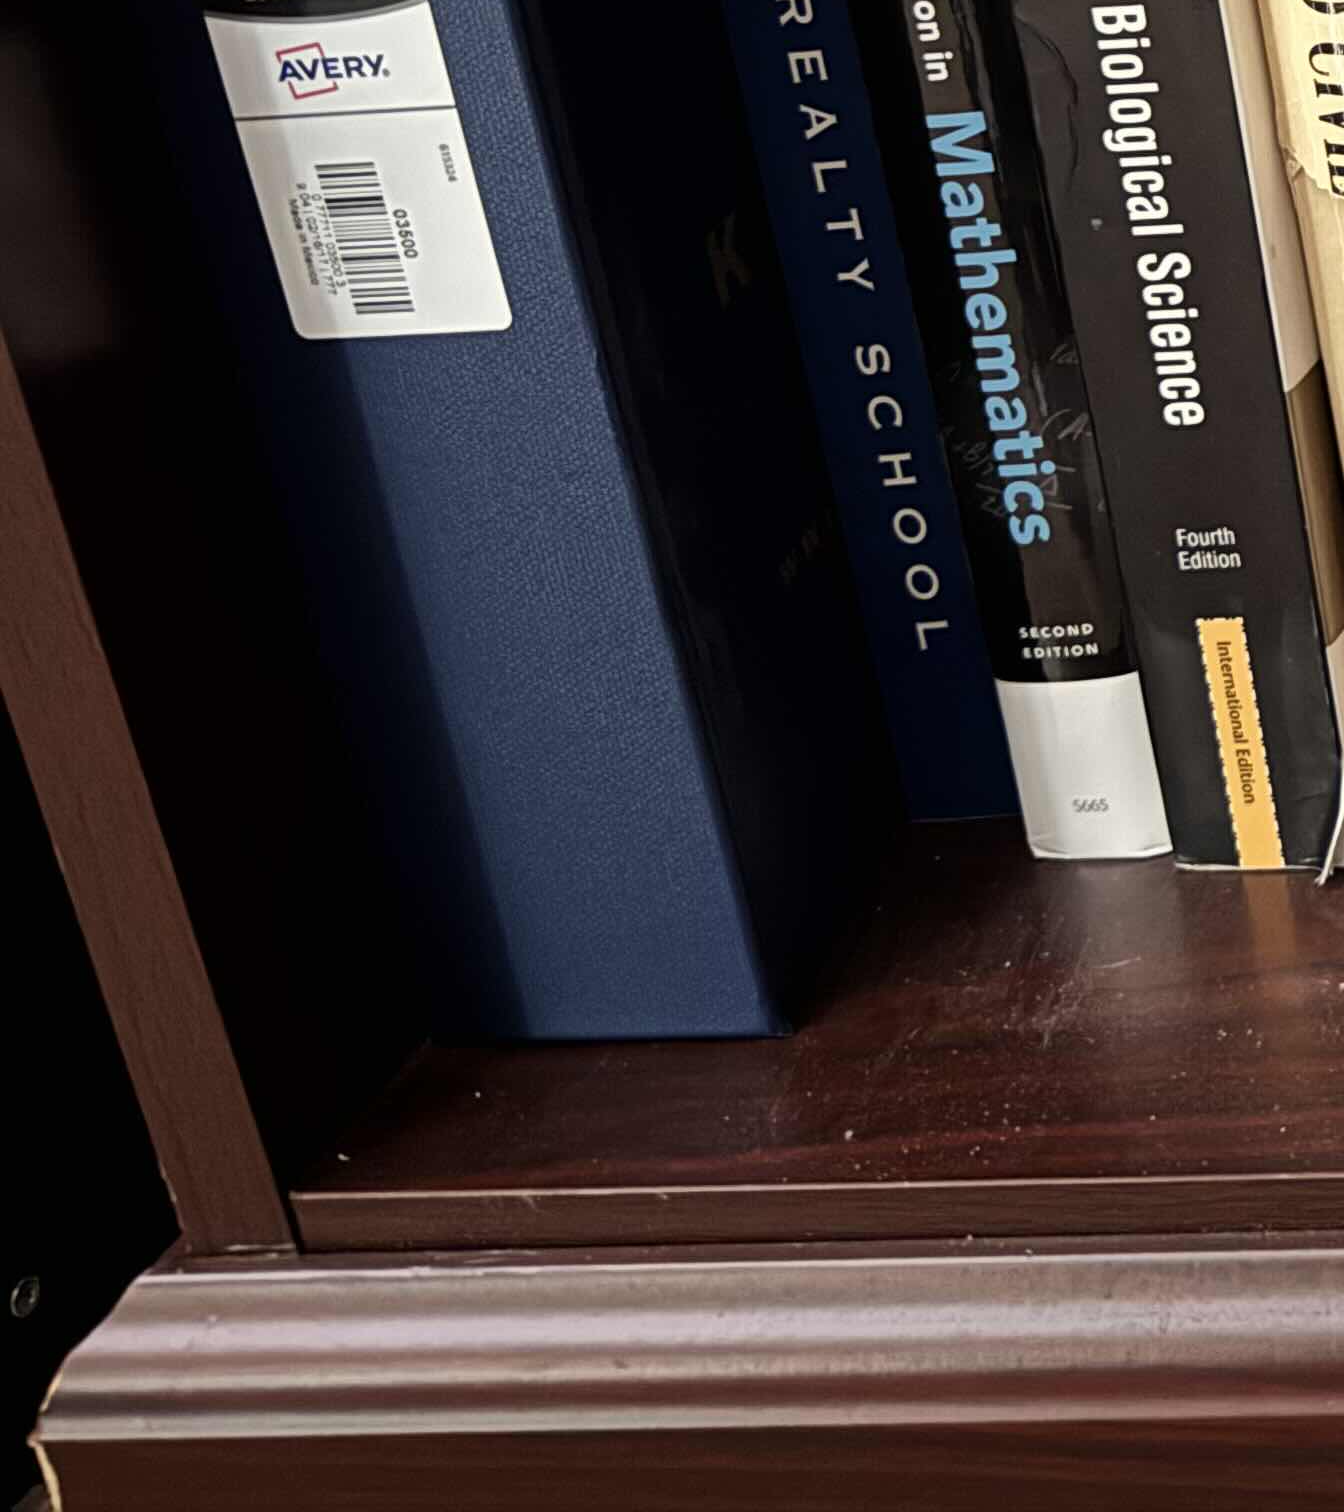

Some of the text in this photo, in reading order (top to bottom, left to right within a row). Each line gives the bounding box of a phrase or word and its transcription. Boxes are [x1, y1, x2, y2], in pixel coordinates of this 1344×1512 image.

[277, 54, 385, 84] AVERY
[922, 46, 950, 83] in
[392, 208, 417, 259] 03500
[1091, 3, 1206, 428] Biological Science
[926, 111, 1058, 546] Mathematics
[855, 342, 950, 652] SCHOOL
[1176, 527, 1237, 549] Fourth
[1177, 548, 1242, 571] Edition
[1018, 621, 1095, 639] SECOND
[1021, 642, 1099, 660] EDITION
[1216, 639, 1256, 806] International Edition
